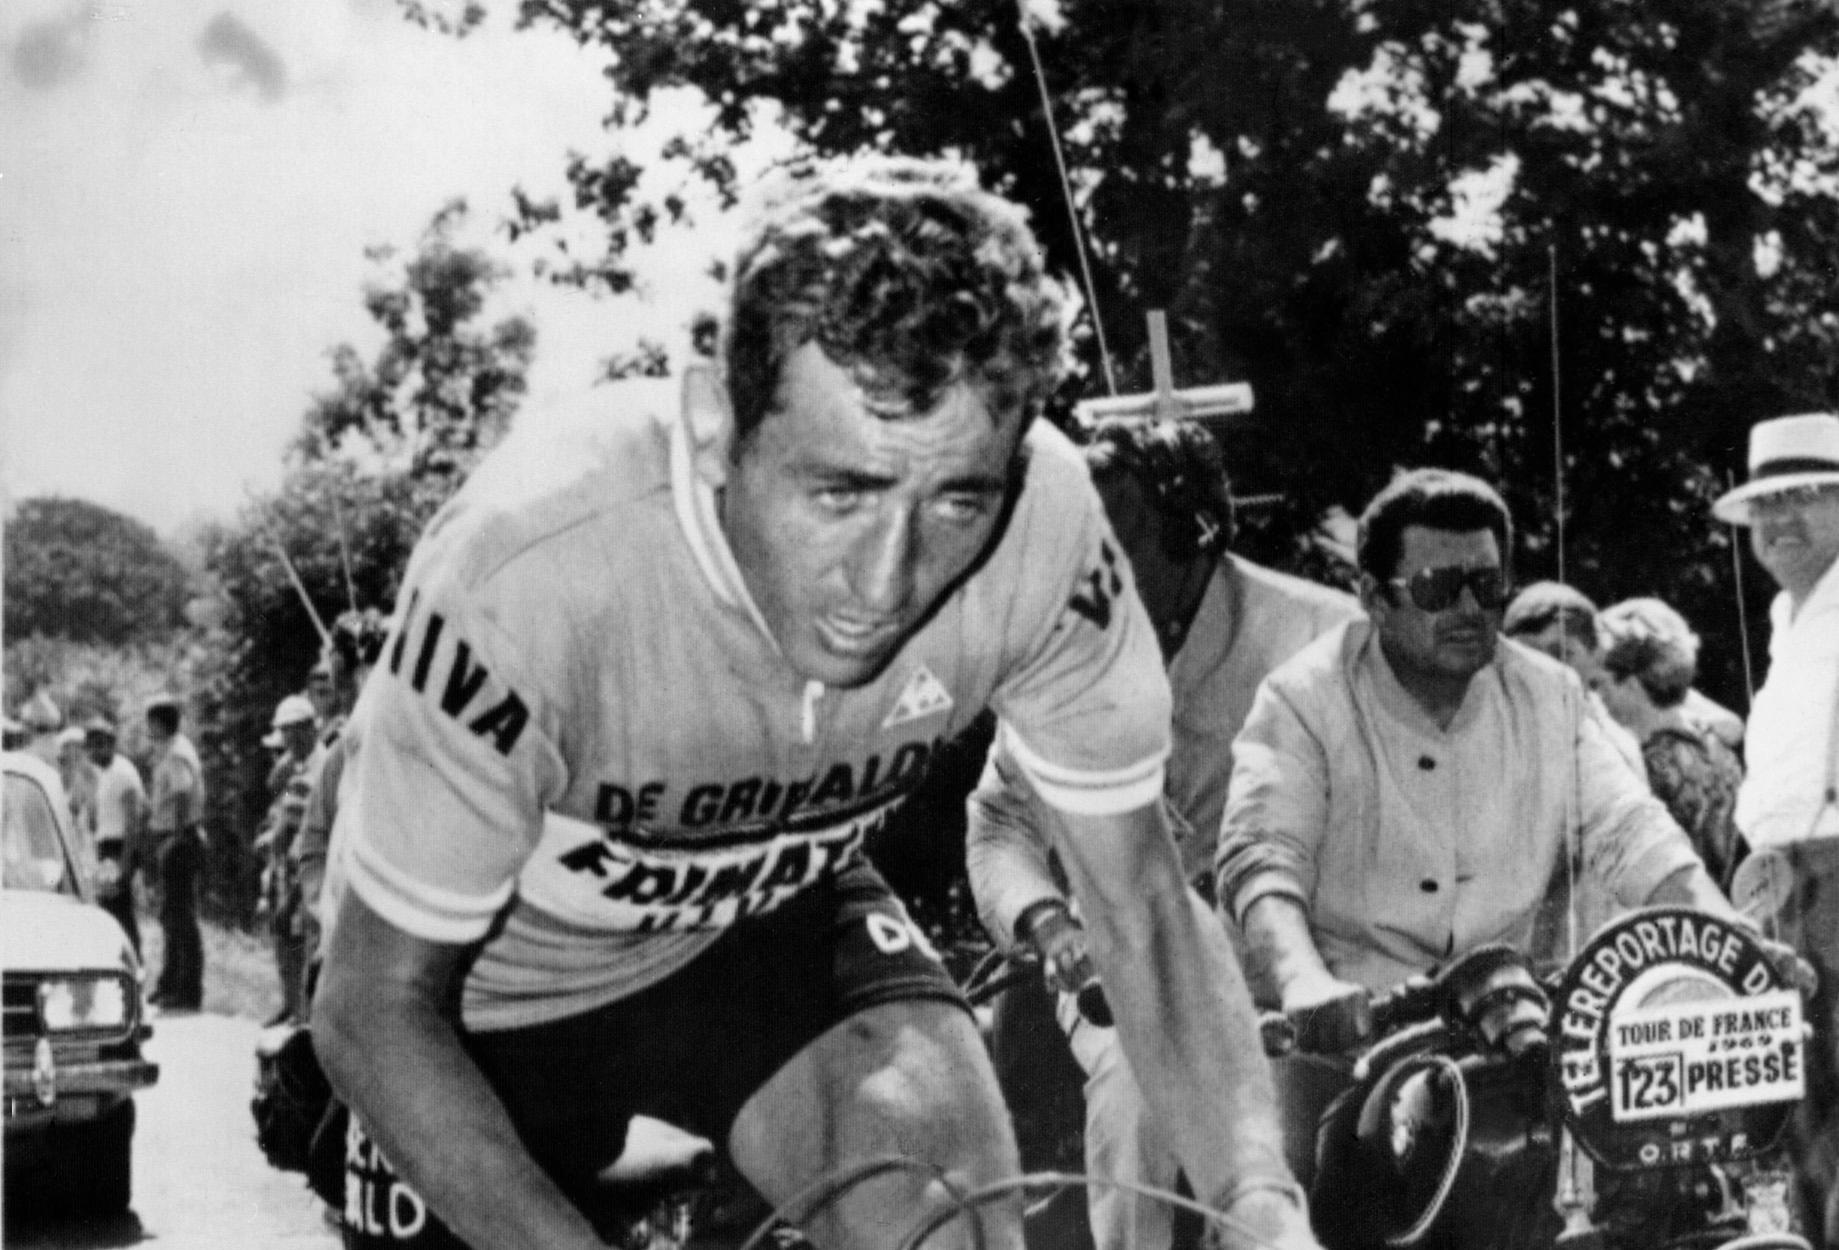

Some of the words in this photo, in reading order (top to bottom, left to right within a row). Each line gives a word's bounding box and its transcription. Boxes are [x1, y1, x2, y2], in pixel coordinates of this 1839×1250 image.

[594, 780, 666, 826] DE
[1617, 1020, 1673, 1047] TOUR
[1678, 1016, 1705, 1040] DE
[1713, 1006, 1792, 1036] FRANCE
[1619, 1060, 1679, 1111] 123
[1688, 1053, 1798, 1094] PRESSE
